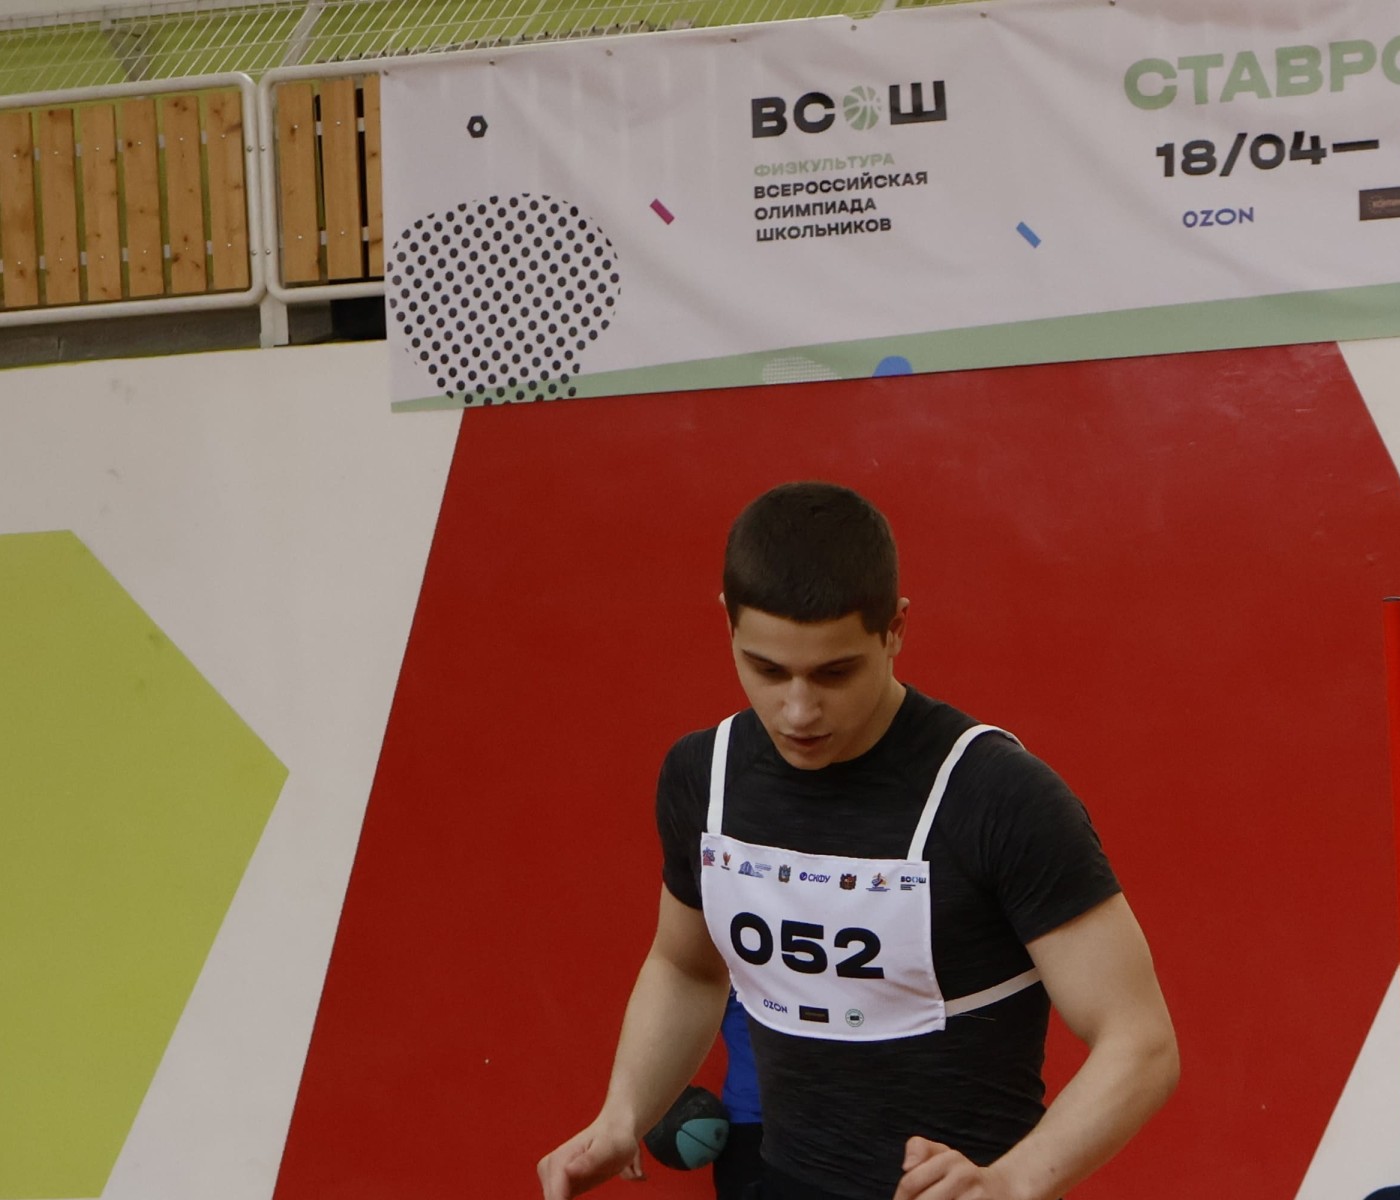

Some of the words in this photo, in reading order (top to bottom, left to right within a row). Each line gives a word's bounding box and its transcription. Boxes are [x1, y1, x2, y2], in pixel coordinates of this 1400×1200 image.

[754, 152, 896, 177] ФИЗКУЛЬТУРА
[753, 171, 929, 199] ВСЕРОССИЙСКАЯ
[754, 197, 877, 220] ОЛИМПИАДА
[1182, 206, 1255, 229] OZON
[756, 217, 893, 242] ШКОЛЬНИКОВ
[730, 912, 885, 979] 052
[763, 998, 788, 1014] OZON
